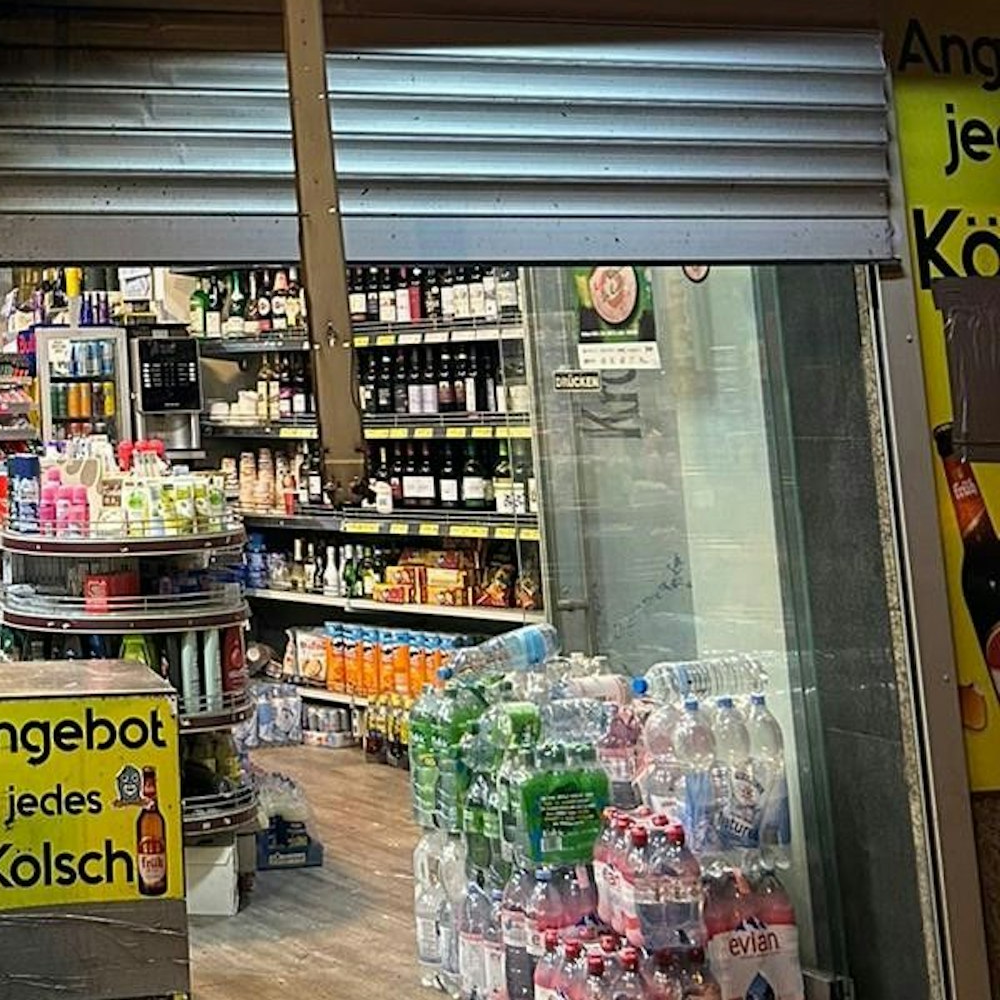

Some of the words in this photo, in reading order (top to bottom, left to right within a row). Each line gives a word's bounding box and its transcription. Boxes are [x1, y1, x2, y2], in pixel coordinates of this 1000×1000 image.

[945, 103, 1000, 177] je
[555, 373, 600, 389] DRÜCKEN
[4, 783, 103, 831] jedes
[729, 930, 779, 957] evian
